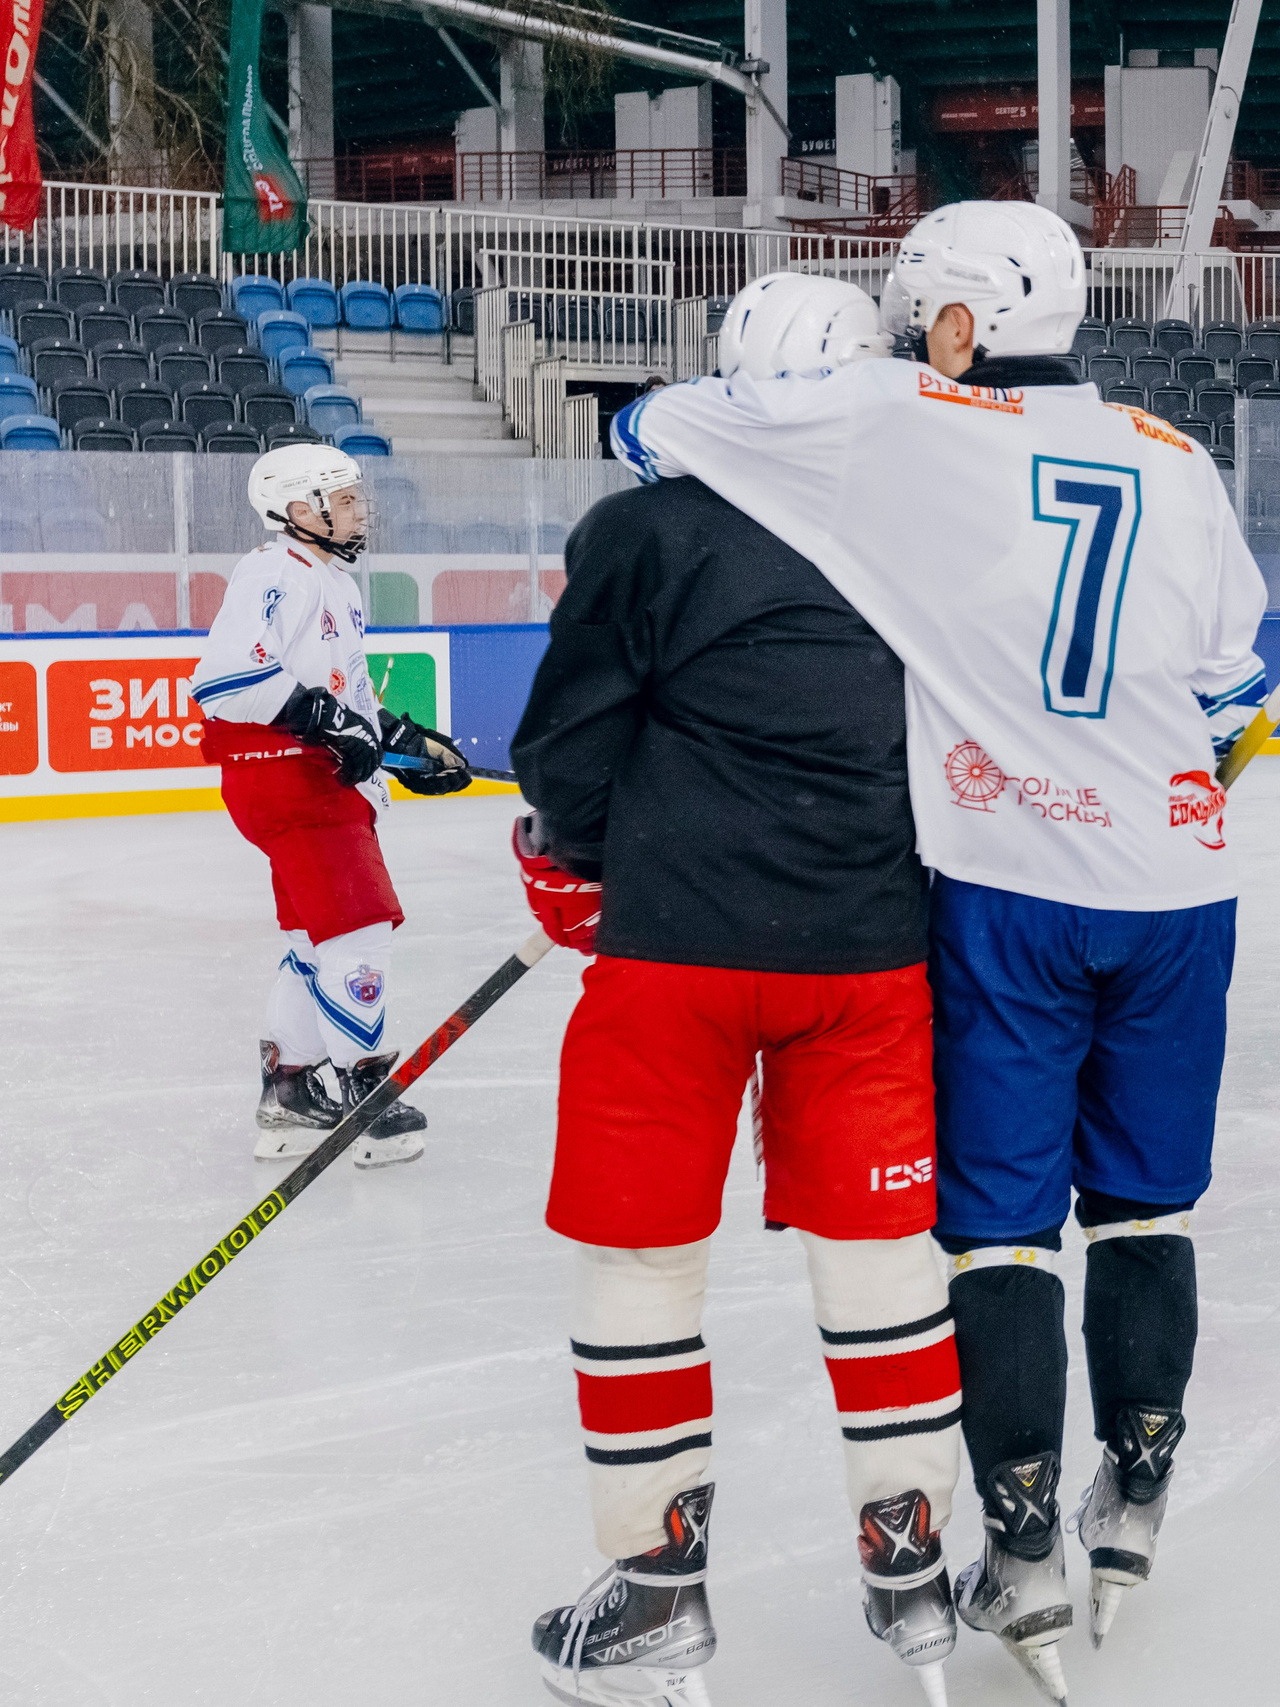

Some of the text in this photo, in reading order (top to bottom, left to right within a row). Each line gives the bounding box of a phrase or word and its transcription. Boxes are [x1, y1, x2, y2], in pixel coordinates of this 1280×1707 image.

[801, 139, 836, 151] БУФЕТ
[1131, 416, 1192, 453] Russia
[1031, 453, 1143, 719] 7
[90, 723, 203, 749] В МОС
[228, 747, 303, 762] TRUE
[56, 1190, 286, 1420] SHERWOOD
[586, 1615, 691, 1663] VAPOR
[903, 1636, 951, 1657] BAUER
